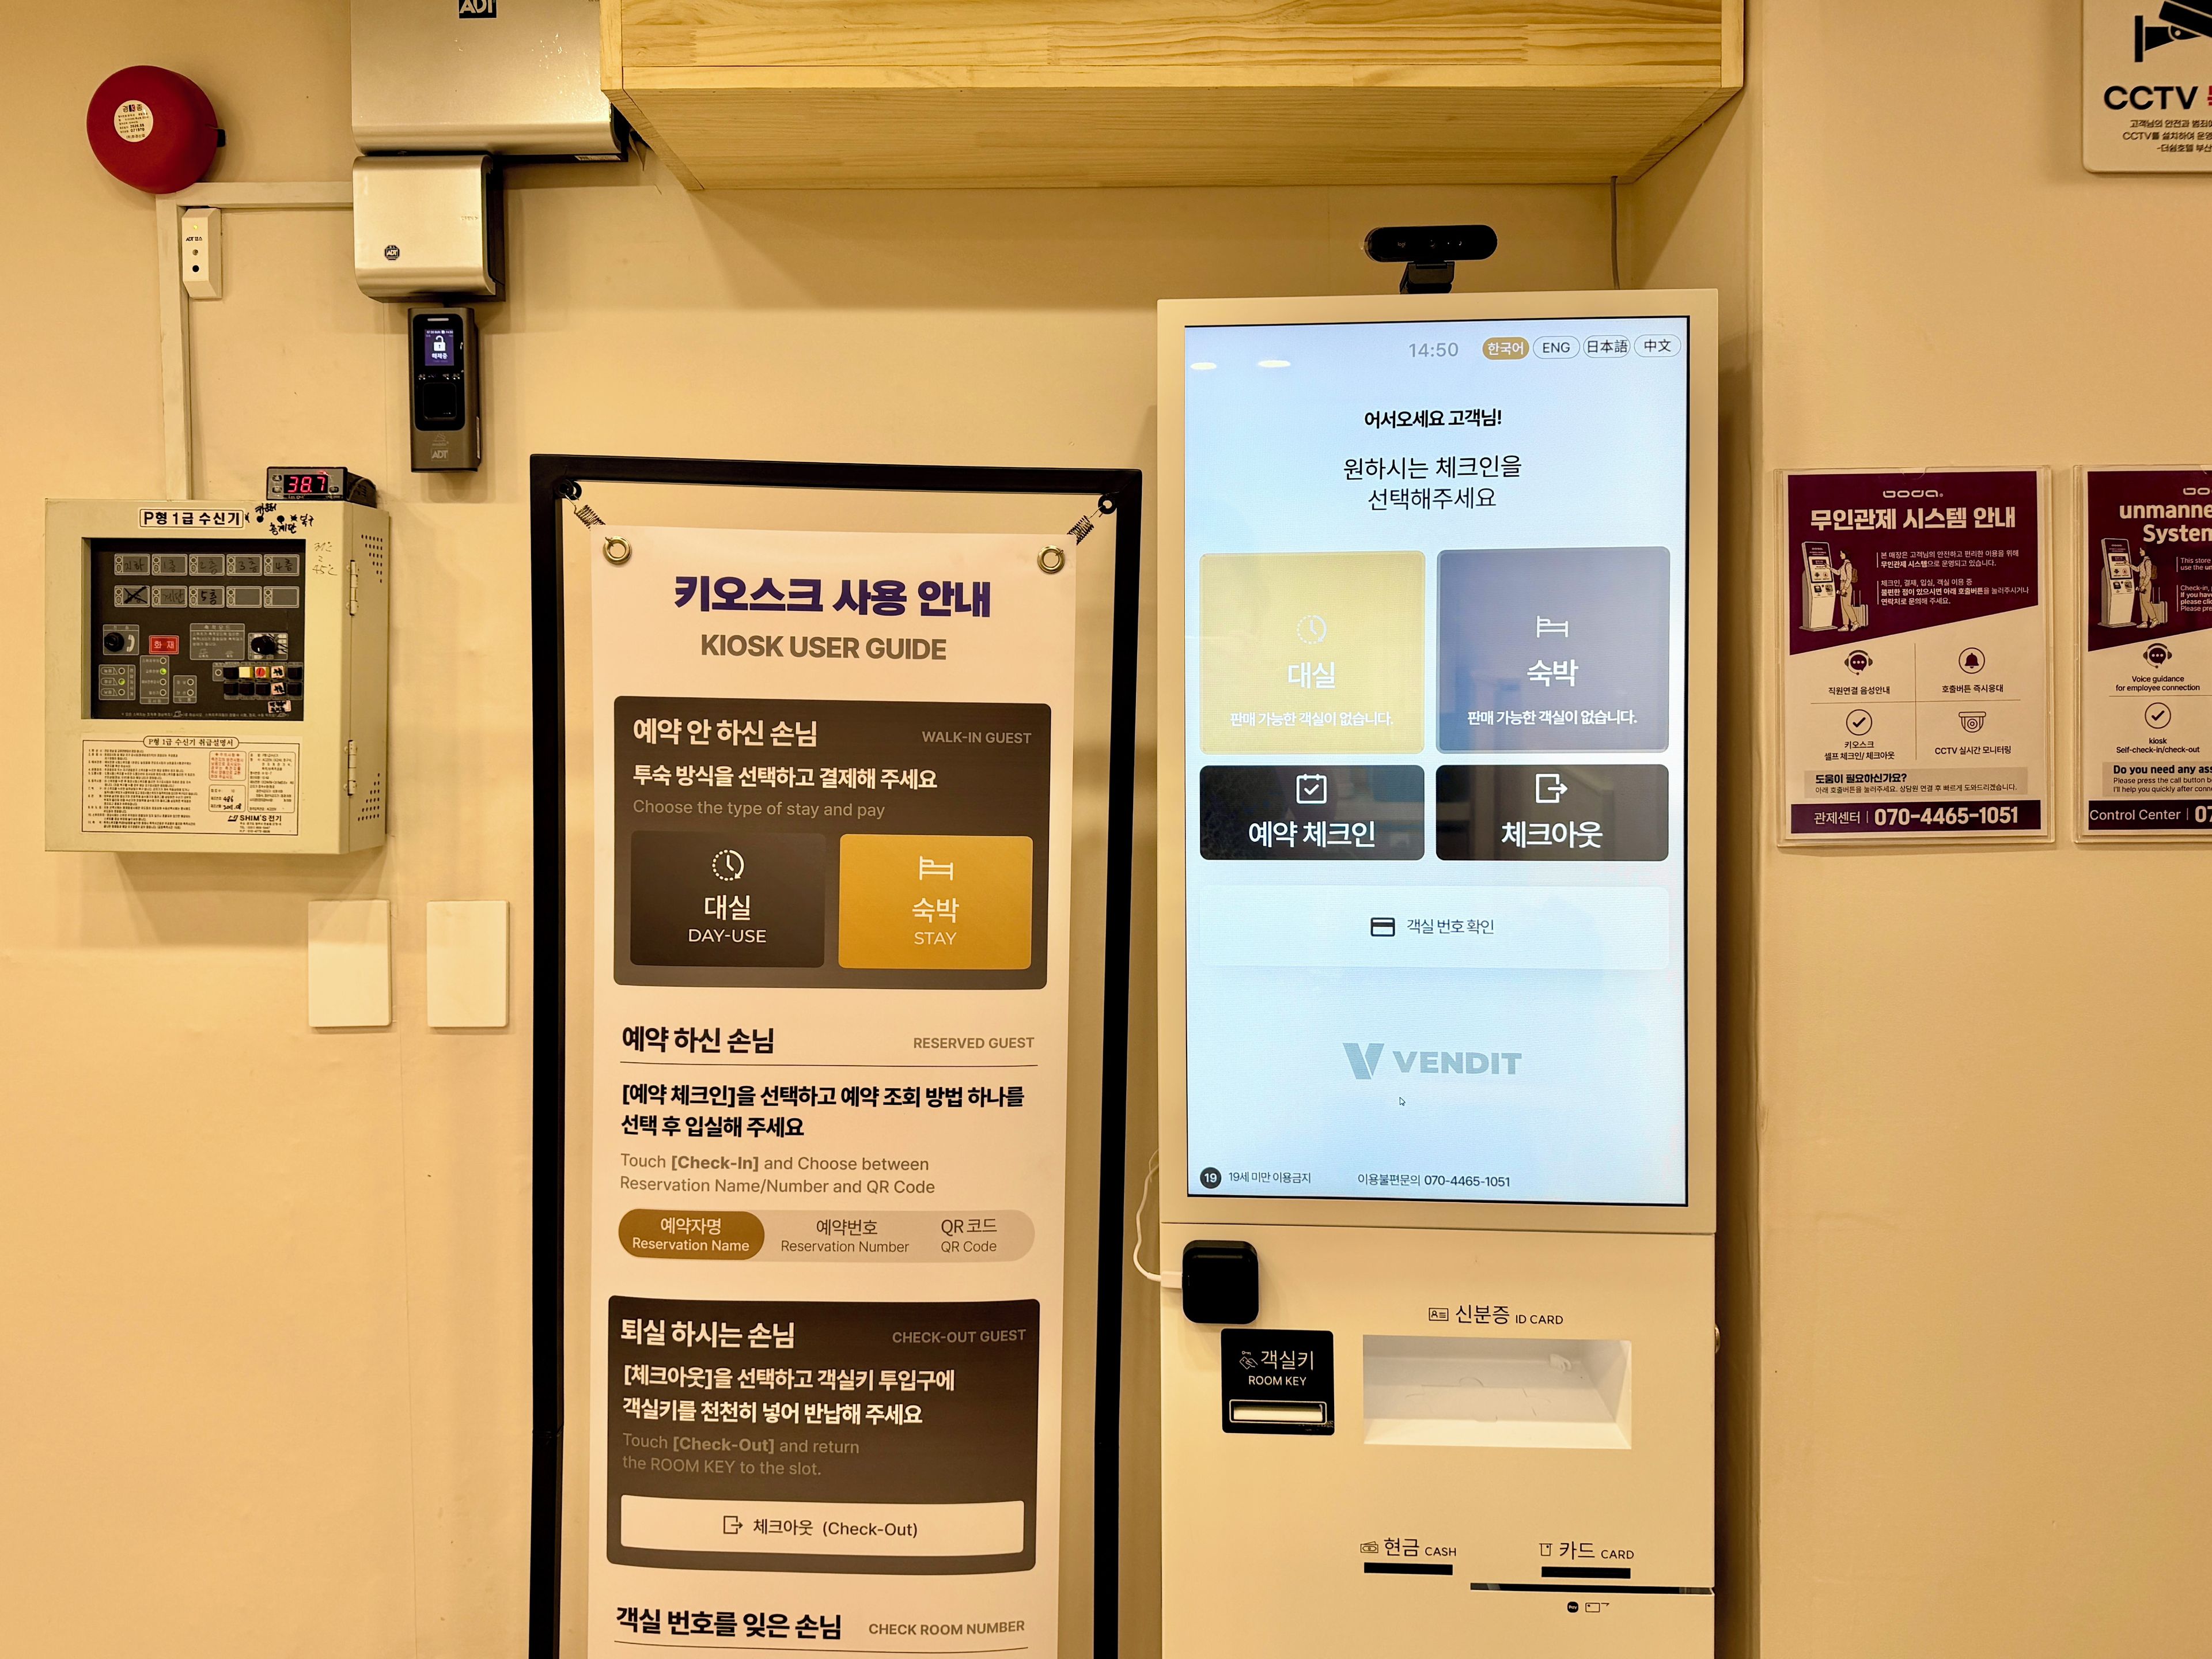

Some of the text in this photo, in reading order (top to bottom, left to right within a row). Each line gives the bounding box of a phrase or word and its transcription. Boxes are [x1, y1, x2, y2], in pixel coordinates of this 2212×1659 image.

[2104, 86, 2198, 110] CCTV
[1410, 343, 1458, 357] 14:50
[1488, 342, 1523, 355] 한국어
[1543, 342, 1570, 353] ENG
[1586, 338, 1628, 354] 日本語
[1645, 339, 1671, 352] 中文
[1365, 408, 1501, 429] 어서오세요 고객님!
[431, 450, 448, 459] ADT
[288, 476, 326, 493] 38.7
[145, 512, 239, 525] P형 1급 수신기
[1811, 507, 2015, 531] 무인관제 시스템 안내
[675, 576, 990, 617] 키오스크 사용 안내
[702, 634, 946, 660] KIOSK USER GUIDE
[1288, 661, 1335, 688] 대실
[1527, 660, 1578, 687] 숙박
[1828, 686, 1889, 695] 직원연결 음성안내
[1942, 684, 2003, 693] 호출버튼 즉시응대
[1468, 710, 1637, 725] 판매 가능한 객실이 없습니다.
[634, 718, 816, 747] 예약 안 하신 손님
[922, 732, 1032, 743] WALK-IN GUEST
[199, 738, 233, 747] 취급설명서
[1844, 741, 1874, 749] 키오스크
[1824, 752, 1839, 760] 셀프
[1866, 752, 1895, 760] 체크아웃
[1960, 747, 1980, 755] 실시간
[1983, 746, 2011, 754] 모니터링
[2113, 765, 2126, 774] Do
[2130, 767, 2147, 775] you
[2151, 765, 2175, 774] need
[1816, 774, 1907, 783] 도움이 필요하신가요?
[1814, 806, 2017, 825] 관제센터 070-4465-1051
[2090, 809, 2181, 820] Control Center
[1249, 821, 1374, 847] 예약 체크인
[1501, 821, 1603, 848] 체크아웃
[705, 895, 750, 920] 대실
[912, 898, 959, 923] 숙박
[1407, 919, 1494, 934] 객실 번호 확인
[689, 929, 766, 942] DAY-USE
[915, 932, 956, 945] STAY
[1392, 1051, 1522, 1074] VENDIT
[1205, 1172, 1310, 1183] 19 19세 미만 이용금지
[1358, 1174, 1509, 1187] 이용불편문의 070-4465-1051
[661, 1217, 721, 1234] 예약자명
[817, 1219, 877, 1236] 예약번호
[941, 1219, 997, 1236] QR 코드
[633, 1237, 749, 1251] Reservation Name
[782, 1240, 909, 1252] Reservation Number
[941, 1241, 997, 1253] QR Code
[1456, 1305, 1563, 1324] 신분증 ID CARD
[621, 1319, 794, 1348] 퇴실 하시는 손님
[893, 1330, 1026, 1343] CHECK-OUT GUEST
[1261, 1350, 1313, 1370] 객실키
[1249, 1376, 1306, 1385] ROOM KEY
[753, 1519, 917, 1538] 체크아웃 (Check-Out)
[1384, 1537, 1456, 1556] 현금 CASH
[1560, 1541, 1634, 1560] 카드 CARD
[616, 1607, 840, 1639] 객실 번호를 잊은 손님
[869, 1620, 1024, 1635] CHECK ROOM NUMBER
